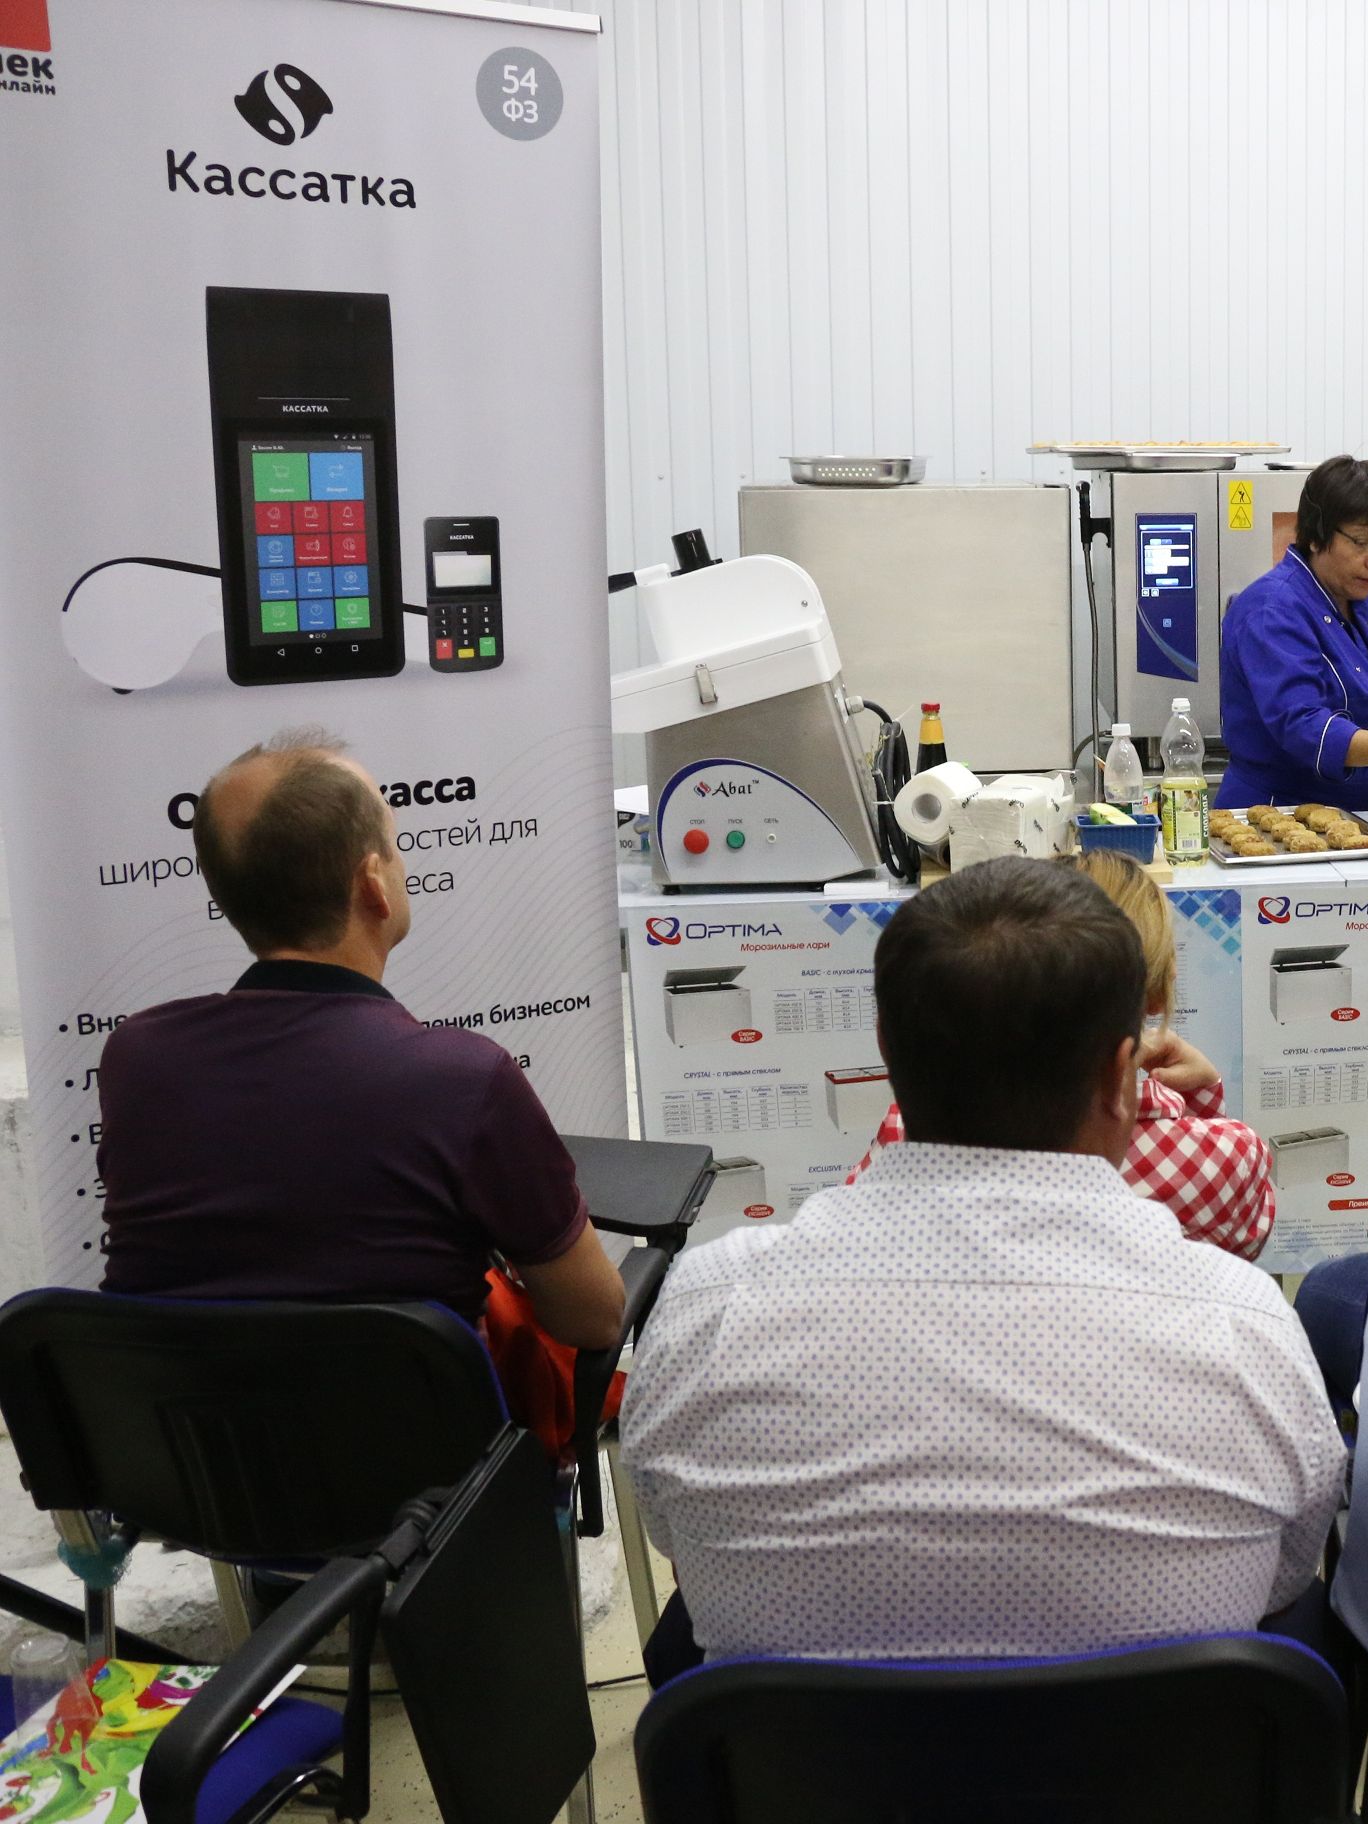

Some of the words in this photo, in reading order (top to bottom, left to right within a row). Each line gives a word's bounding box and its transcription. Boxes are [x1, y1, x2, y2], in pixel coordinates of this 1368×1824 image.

[0, 54, 54, 79] ек
[0, 80, 56, 95] нлайн
[501, 65, 538, 96] 54
[502, 99, 538, 123] ФЗ
[166, 149, 416, 208] Кассатка
[712, 781, 753, 797] Abat
[397, 818, 481, 851] остей
[489, 819, 537, 845] для
[686, 922, 783, 939] OPTIMA
[740, 943, 805, 952] Морозильные
[806, 941, 831, 951] лари
[801, 969, 821, 977] BASIC
[489, 995, 591, 1024] бизнесом
[1283, 1048, 1309, 1056] CRYSTAL
[683, 1071, 711, 1079] CRYSTAL
[808, 1164, 842, 1174] EXCLUSIVE
